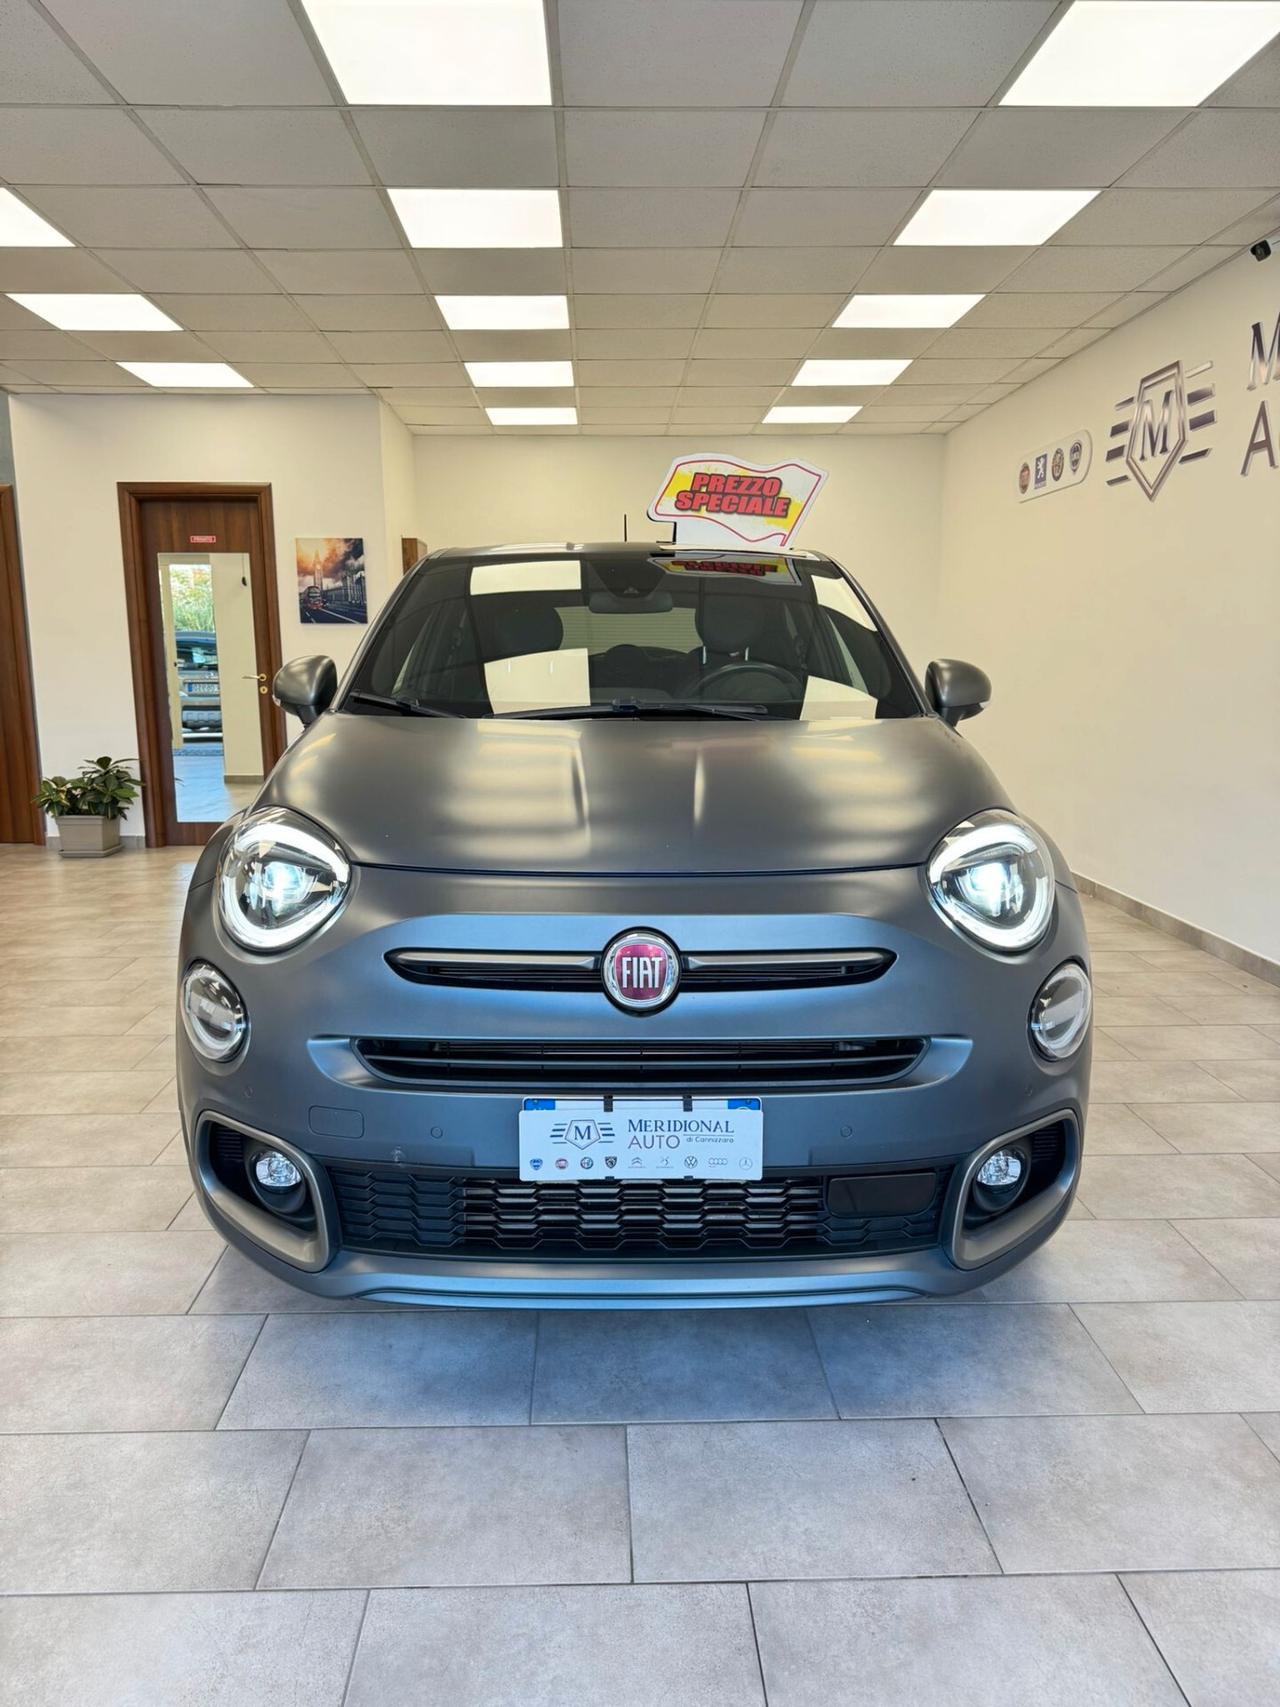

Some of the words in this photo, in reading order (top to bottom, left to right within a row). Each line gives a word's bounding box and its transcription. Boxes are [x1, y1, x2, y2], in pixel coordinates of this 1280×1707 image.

[692, 472, 783, 497] PREZZO
[674, 490, 792, 518] SPECIALE
[621, 956, 664, 989] FIAT
[574, 1125, 591, 1140] M
[627, 1118, 735, 1134] MERIDIONAL
[627, 1134, 681, 1150] AUTO
